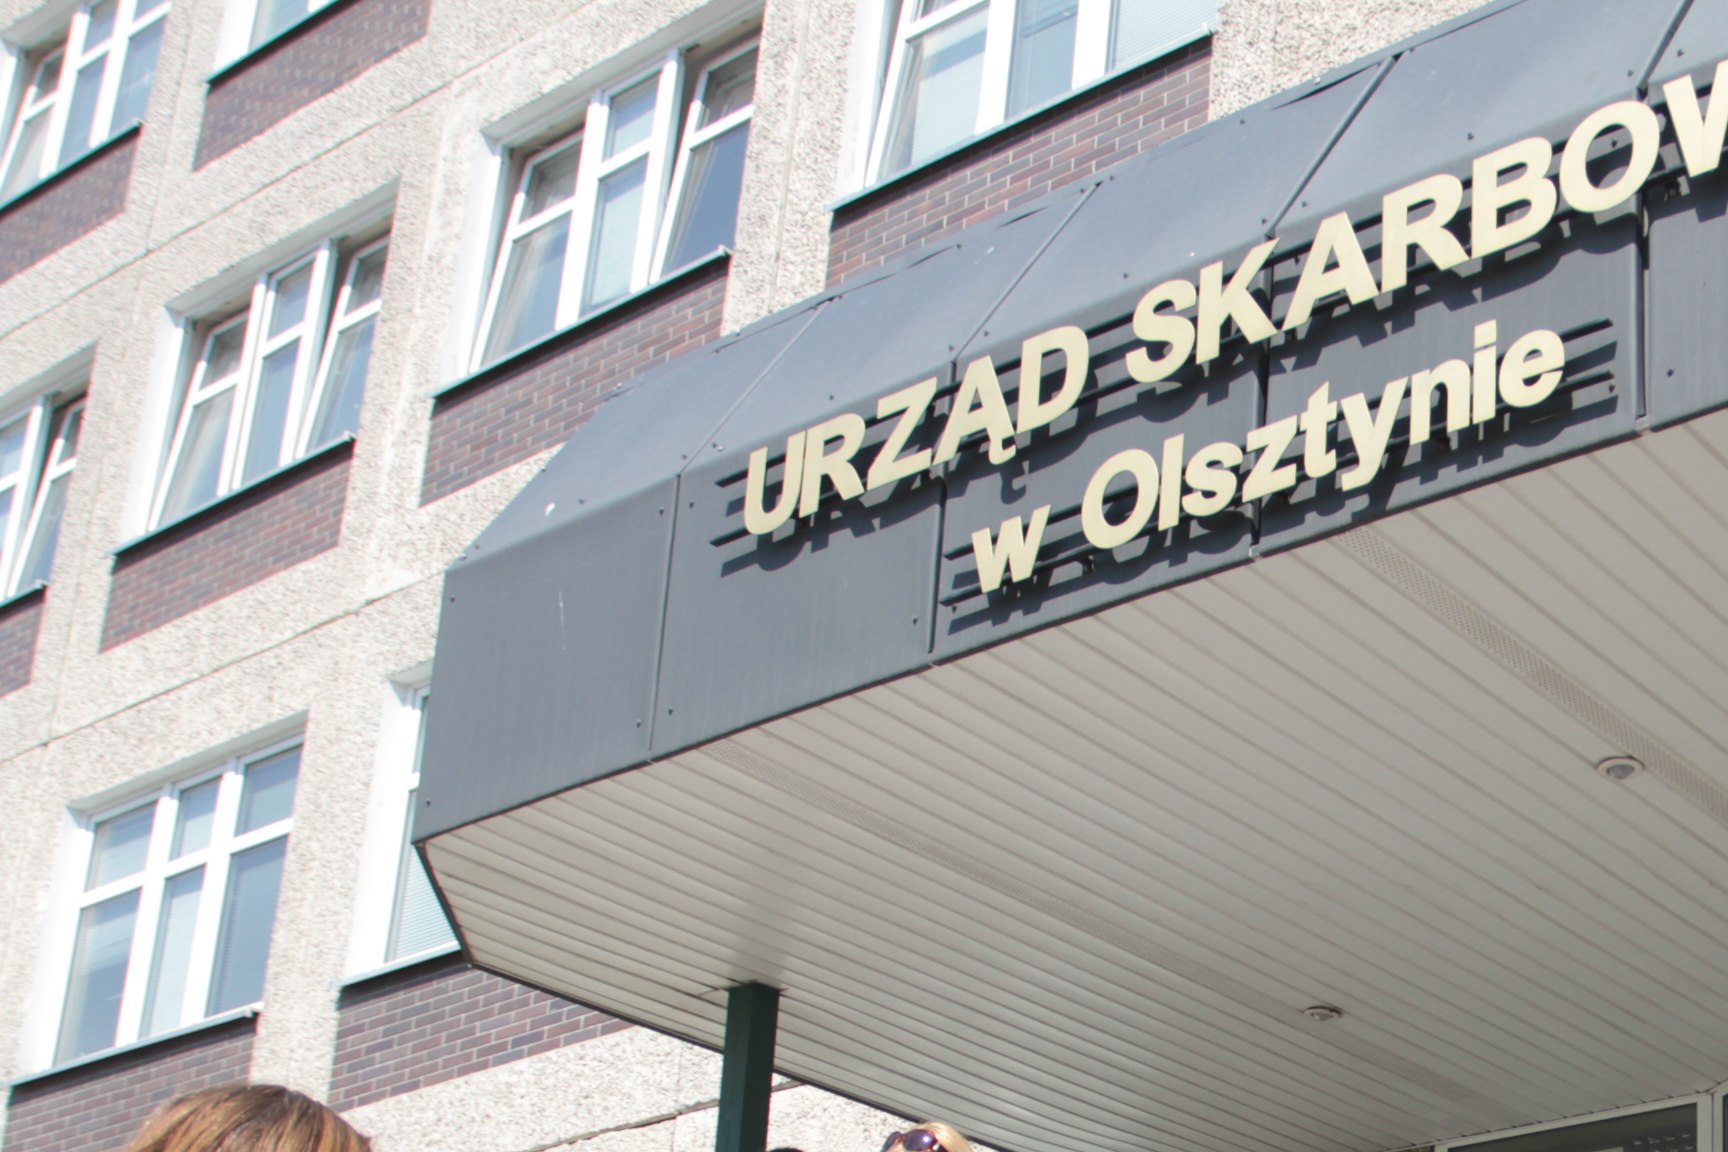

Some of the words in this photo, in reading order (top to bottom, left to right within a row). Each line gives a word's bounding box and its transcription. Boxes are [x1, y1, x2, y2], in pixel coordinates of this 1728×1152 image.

[743, 325, 1090, 535] URZĄD
[971, 504, 1051, 594] w
[1081, 319, 1565, 549] Olsztynie
